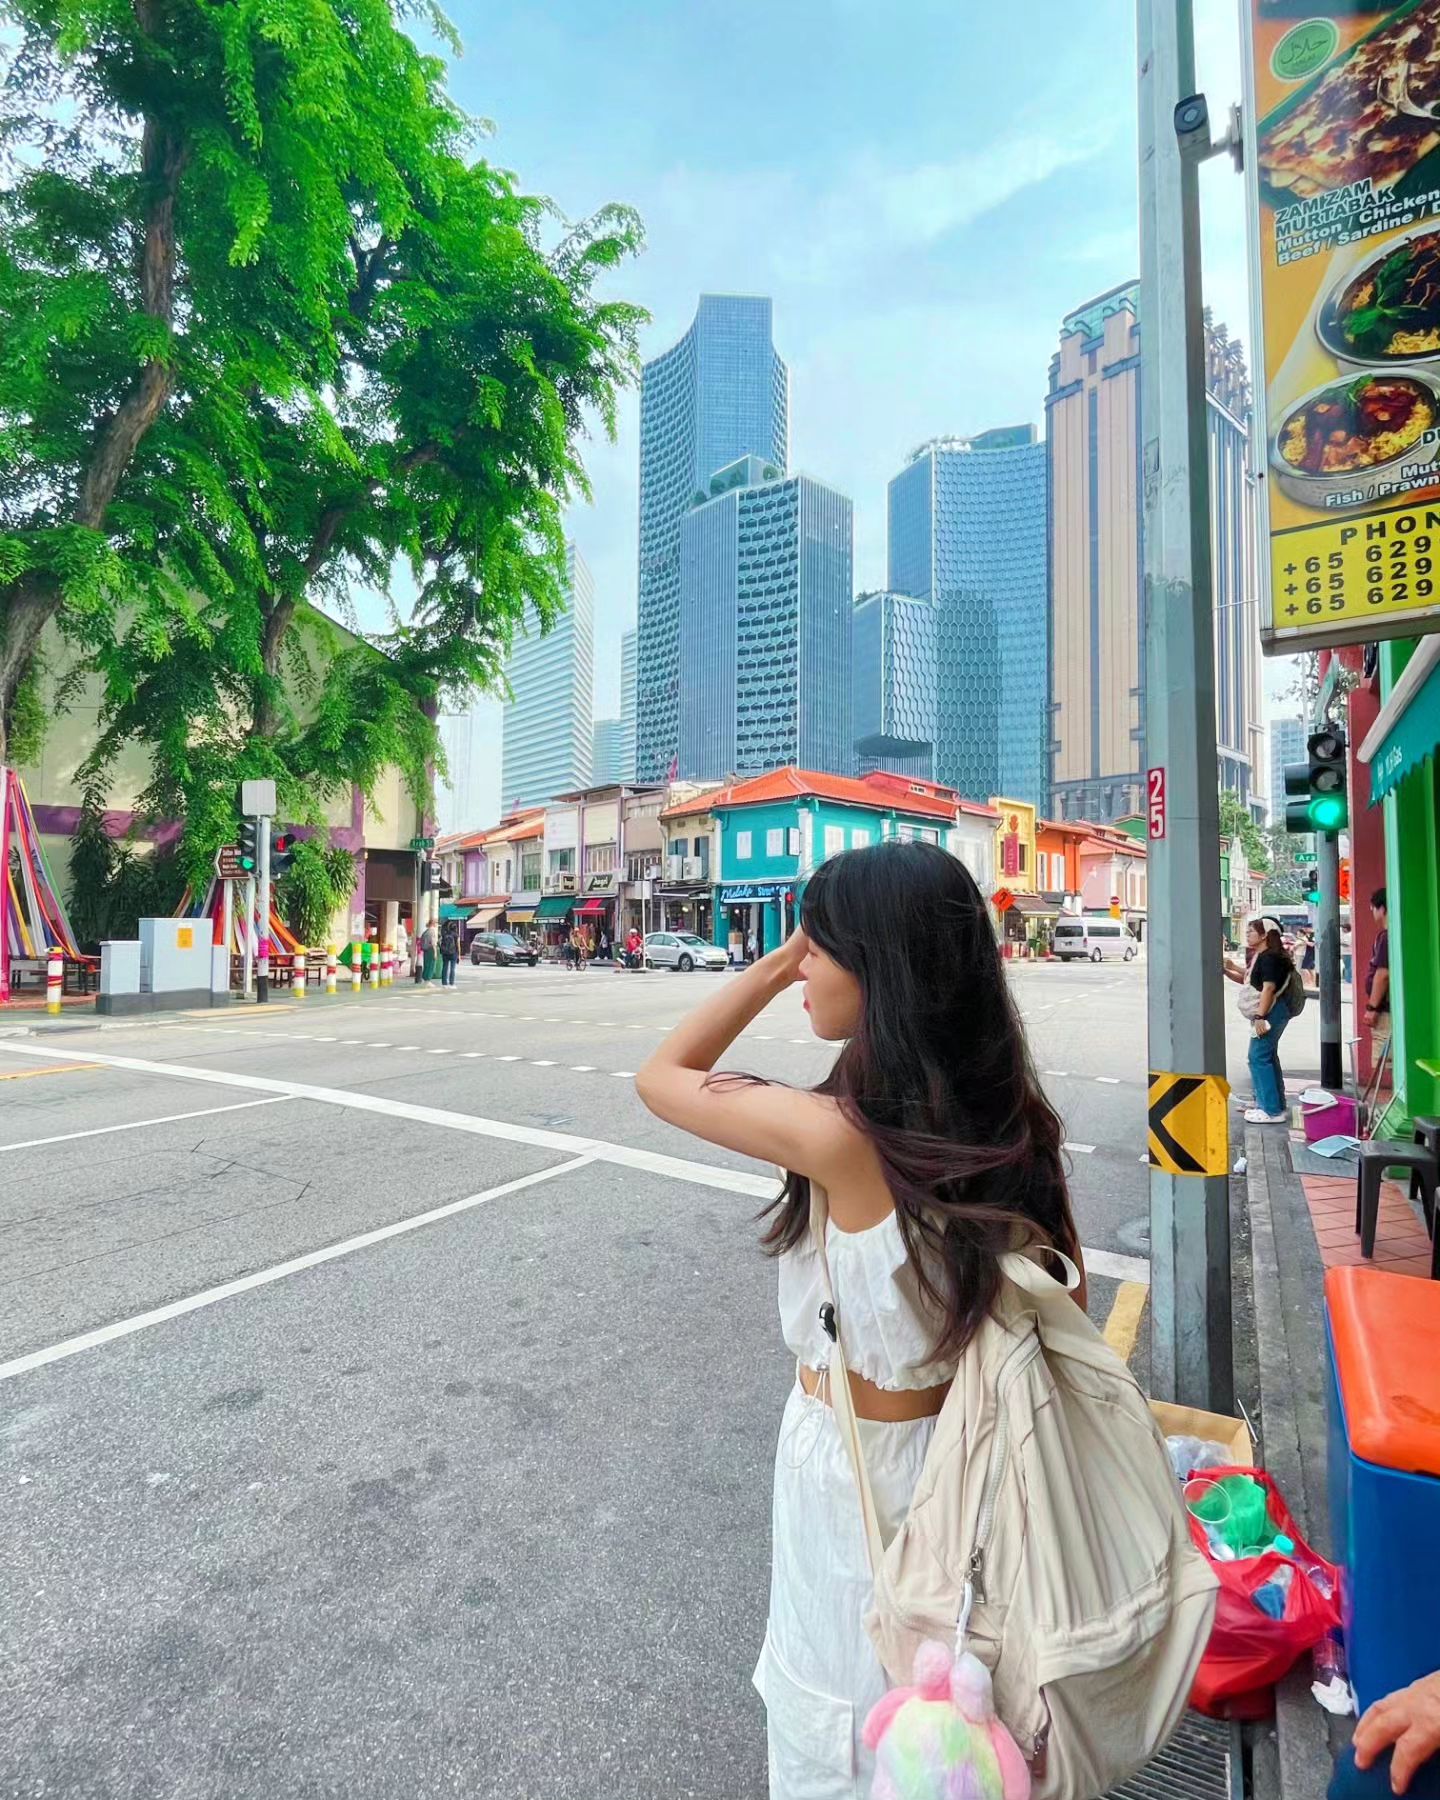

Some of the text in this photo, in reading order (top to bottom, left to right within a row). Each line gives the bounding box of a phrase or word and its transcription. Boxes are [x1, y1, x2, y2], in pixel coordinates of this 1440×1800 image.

[1281, 38, 1328, 64] حلال
[1275, 178, 1371, 223] ZAM ZAM
[1275, 185, 1394, 239] MURTABAK
[1278, 223, 1342, 253] Mutton
[1360, 189, 1440, 224] Chicken
[1278, 241, 1320, 266] Beef
[1337, 213, 1414, 245] Sardine
[1325, 490, 1363, 507] Fish
[1379, 475, 1439, 496] Prawn
[1402, 460, 1440, 478] Mut
[1150, 769, 1164, 838] 25
